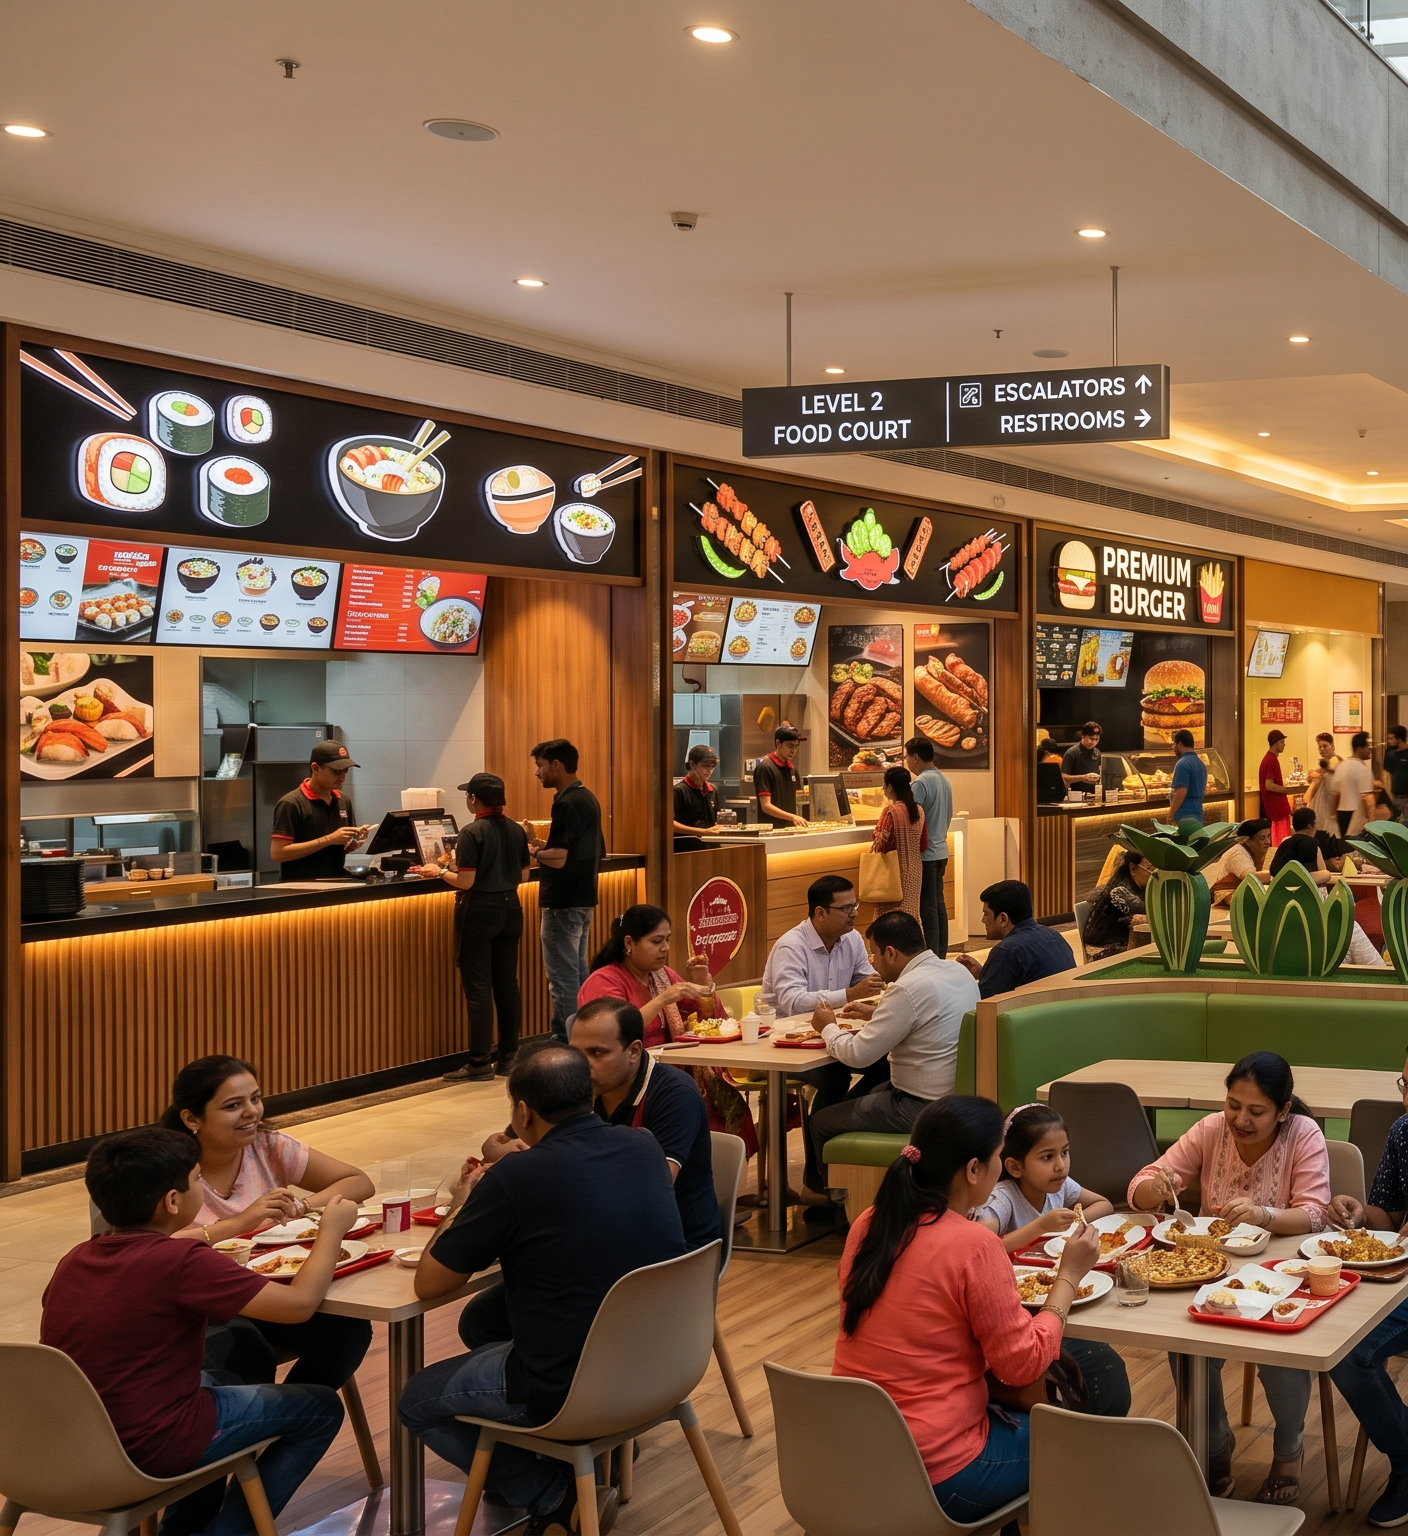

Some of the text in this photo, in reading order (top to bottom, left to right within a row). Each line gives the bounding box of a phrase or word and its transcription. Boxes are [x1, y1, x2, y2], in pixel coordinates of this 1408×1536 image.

[994, 376, 1126, 403] ESCALATORS
[801, 391, 884, 415] LEVEL 2
[774, 419, 912, 445] FOOD COURT
[1000, 409, 1126, 434] RESTROOMS
[1103, 545, 1191, 588] PREMIUM
[1110, 583, 1186, 621] BURGER
